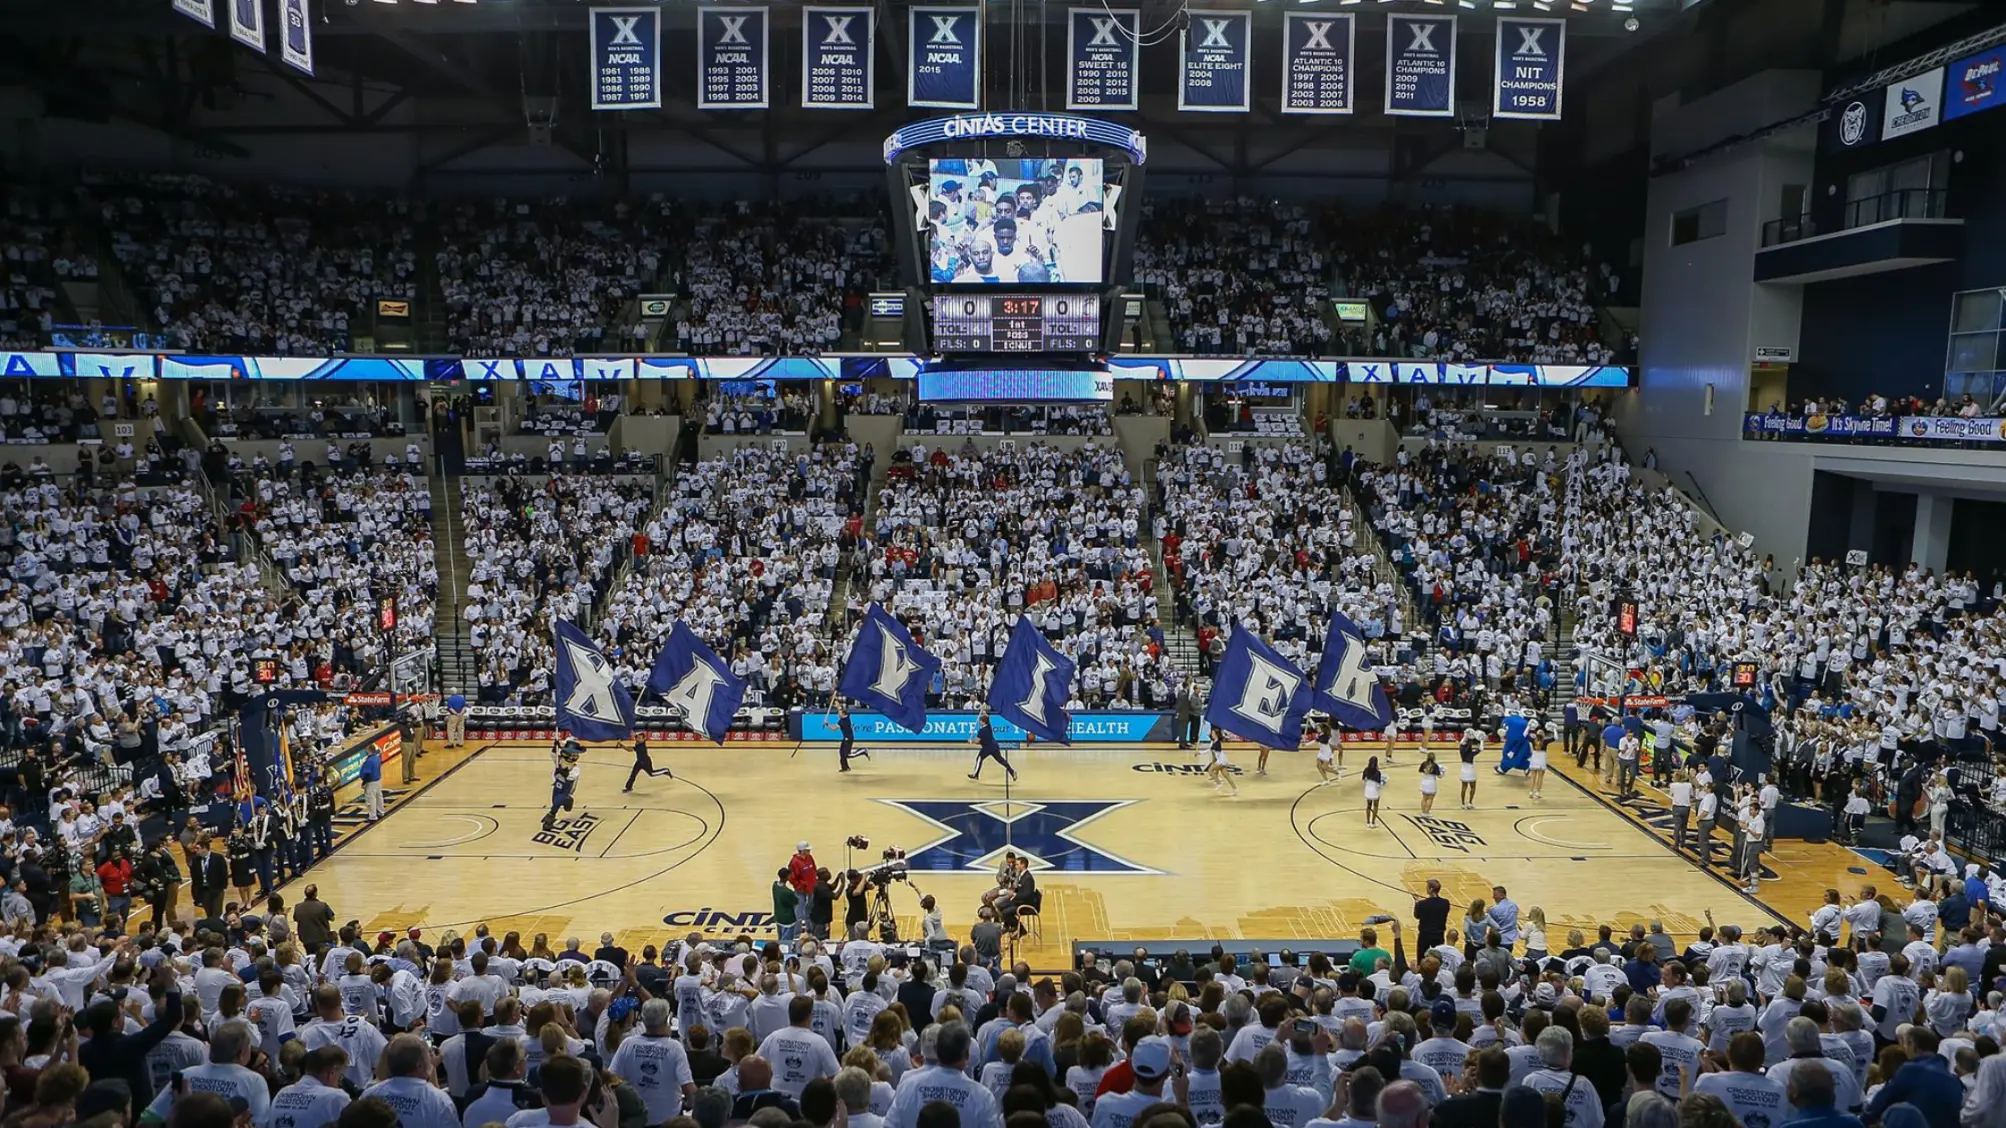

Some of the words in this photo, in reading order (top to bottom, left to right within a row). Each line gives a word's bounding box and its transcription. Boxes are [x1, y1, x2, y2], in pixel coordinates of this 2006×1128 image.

[290, 13, 301, 28] 33
[609, 15, 642, 45] X
[717, 15, 749, 44] X
[822, 15, 855, 44] X
[928, 15, 961, 44] X
[1087, 16, 1120, 46] X
[1199, 18, 1233, 48] X
[1302, 20, 1335, 50] X
[1405, 22, 1438, 52] X
[1514, 27, 1546, 55] X
[608, 54, 642, 64] NCAA
[715, 53, 750, 63] NCAA
[821, 54, 855, 64] NCAA
[928, 53, 962, 64] NCAA
[1079, 61, 1113, 69] SWEET
[1215, 62, 1242, 70] EIGHT
[1396, 66, 1445, 74] CHAMPIONS
[841, 68, 862, 76] 2010
[1516, 67, 1543, 79] NIT
[1077, 87, 1100, 95] 2008
[1501, 80, 1556, 90] CHAMPIONS
[1291, 99, 1314, 107] 2003
[1512, 96, 1546, 107] 1958
[1011, 115, 1088, 137] CENTER
[964, 301, 975, 316] 0
[1003, 301, 1039, 314] 3:17
[1057, 301, 1068, 314] 0
[1008, 321, 1025, 329] 1st
[973, 339, 980, 348] 0
[1086, 339, 1092, 348] 0
[1361, 365, 1380, 382] X
[1410, 368, 1427, 383] A
[1764, 416, 1785, 431] Feeling
[1786, 417, 1802, 429] Good
[1872, 418, 1892, 432] Time!
[1935, 419, 1965, 437] Feeling
[1968, 420, 1991, 435] Good
[561, 637, 625, 725] X
[1230, 647, 1300, 733] E
[189, 1076, 238, 1088] CROSSTOWN
[919, 1086, 970, 1098] CROSSTOWN
[1726, 1087, 1781, 1098] CROSSTOWN
